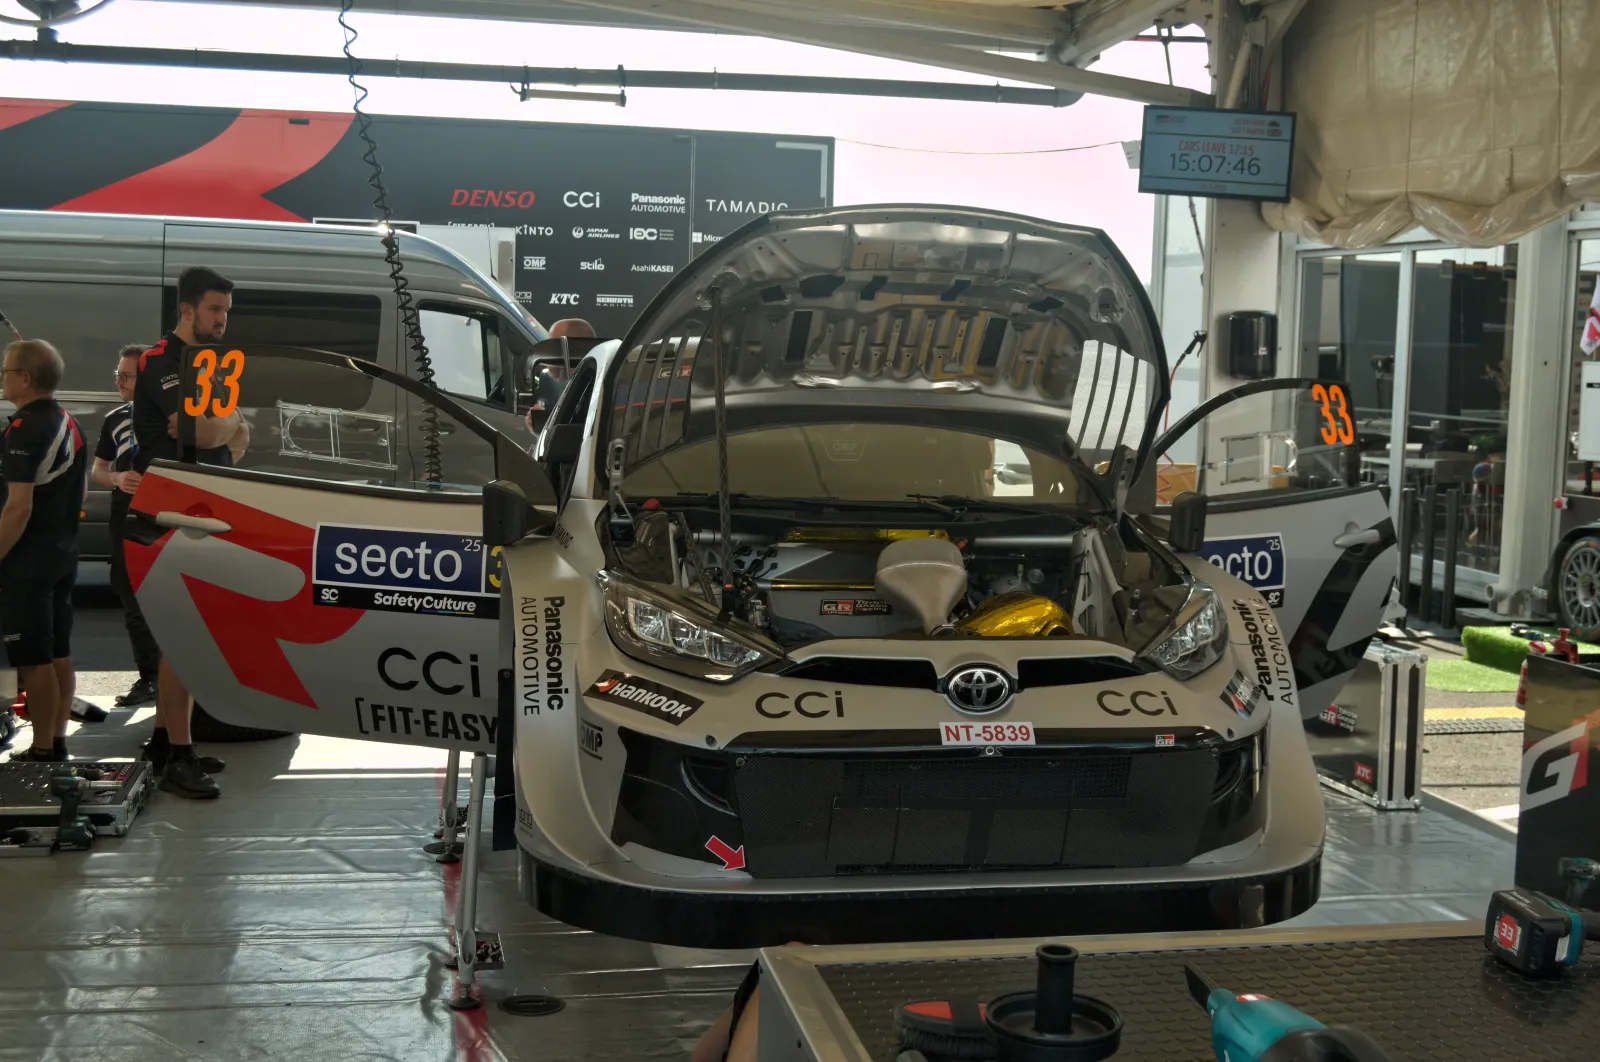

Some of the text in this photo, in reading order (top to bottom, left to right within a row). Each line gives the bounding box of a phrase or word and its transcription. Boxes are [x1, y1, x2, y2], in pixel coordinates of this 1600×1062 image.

[1178, 140, 1200, 152] CARS
[1202, 142, 1226, 154] LEAVE
[1169, 153, 1262, 176] 15:07:46
[450, 189, 536, 209] DENSO
[631, 193, 686, 204] Panasonic
[630, 204, 686, 214] AUTOMOTIVE
[523, 258, 547, 268] OMP
[580, 257, 605, 271] Stilo
[548, 293, 580, 305] KTC
[184, 349, 245, 418] 33
[1312, 384, 1354, 445] 33
[335, 540, 463, 583] secto
[321, 588, 340, 601] SC
[373, 592, 477, 612] SafetyCulture
[822, 602, 854, 611] GR
[520, 597, 540, 716] AUTOMOTIVE
[543, 596, 569, 711] Panasonic
[1233, 598, 1275, 702] Panasonic
[1251, 598, 1294, 705] AUTOMOTIVE
[943, 724, 1032, 742] NT-5839
